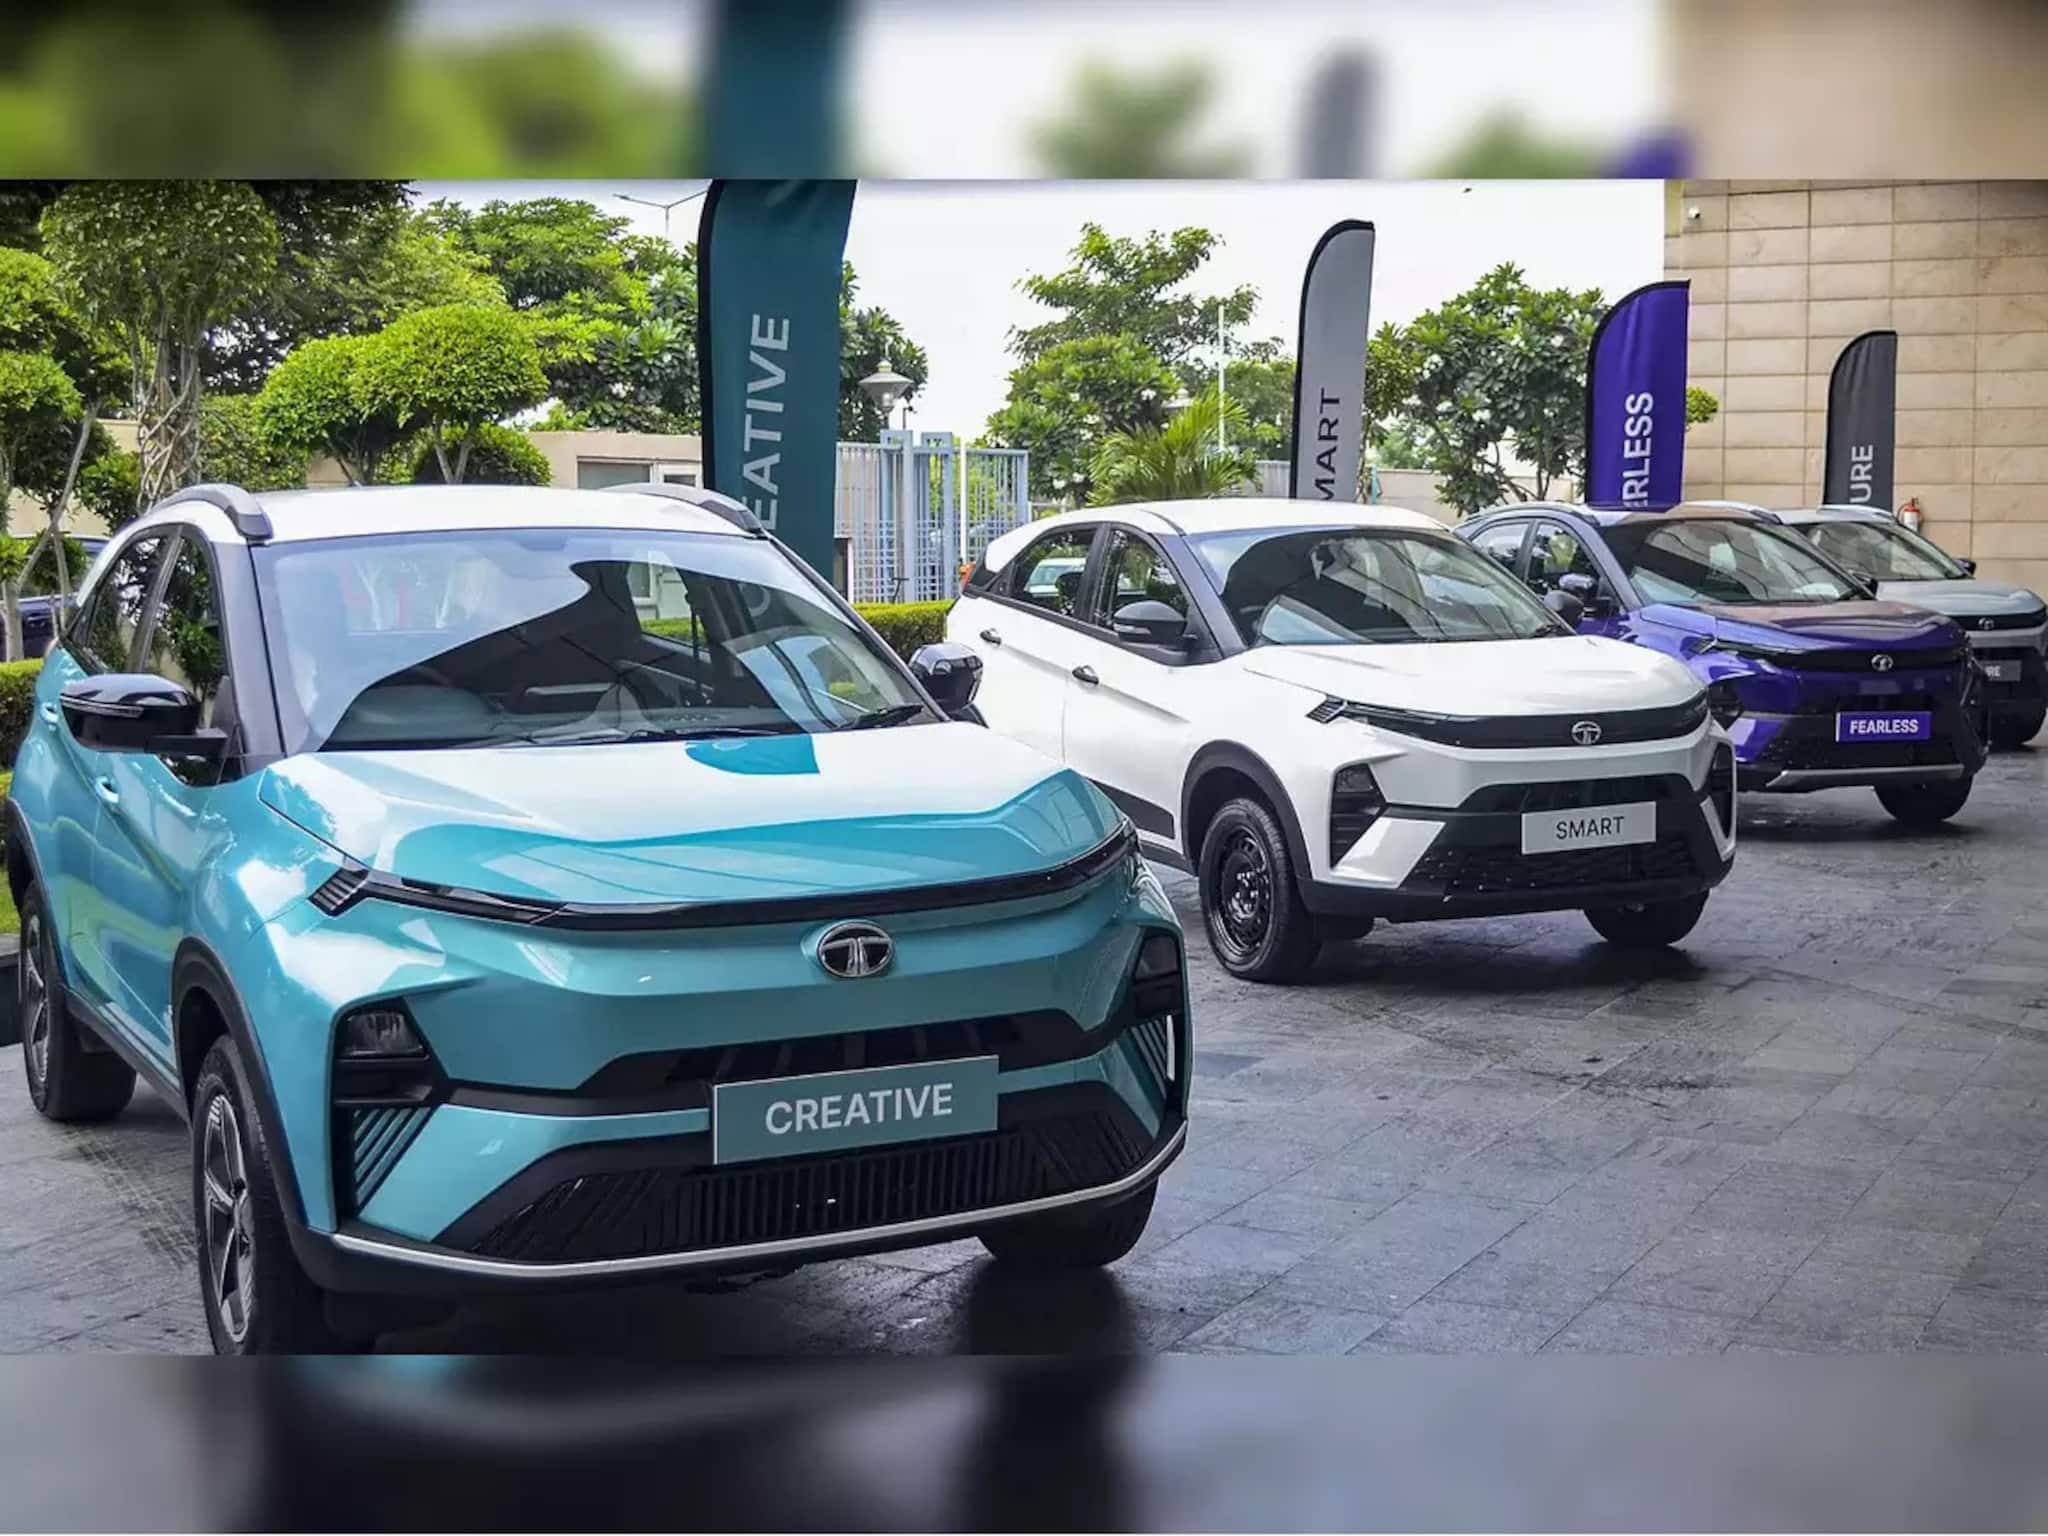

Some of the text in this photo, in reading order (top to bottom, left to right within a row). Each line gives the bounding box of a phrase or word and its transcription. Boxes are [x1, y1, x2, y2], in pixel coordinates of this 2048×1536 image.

[1849, 444, 1873, 503] URE
[1850, 719, 1919, 735] FEARLESS
[1556, 815, 1625, 840] SMART
[765, 1082, 953, 1135] CREATIVE
